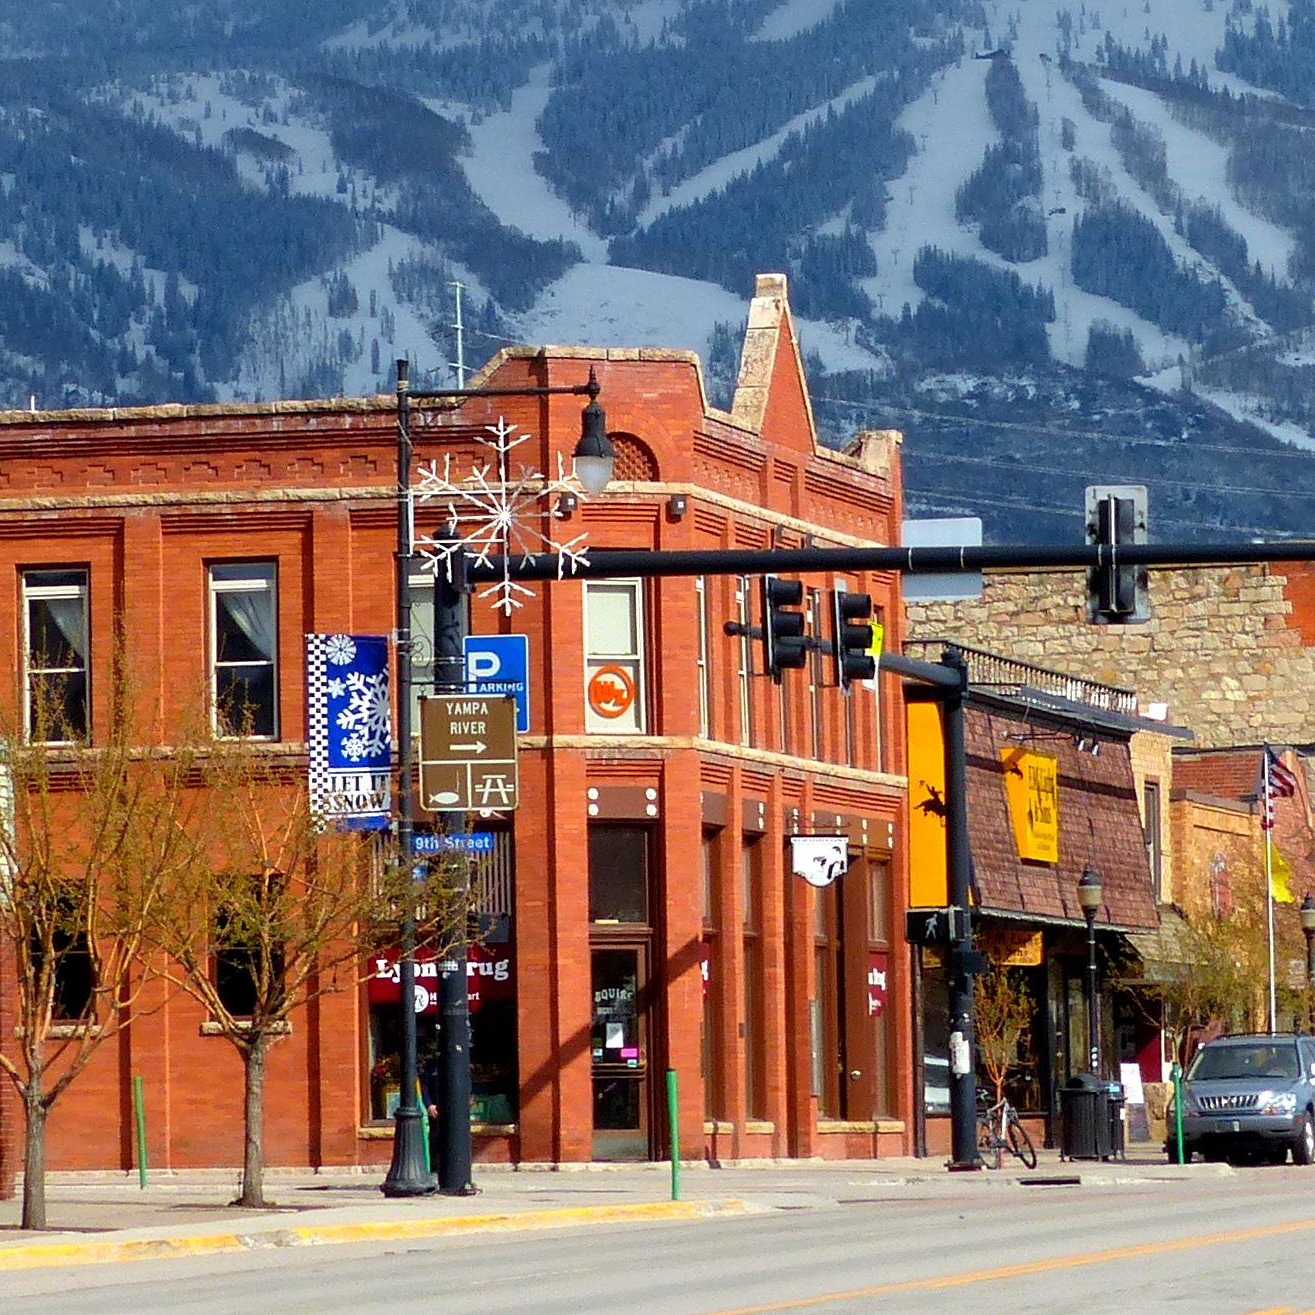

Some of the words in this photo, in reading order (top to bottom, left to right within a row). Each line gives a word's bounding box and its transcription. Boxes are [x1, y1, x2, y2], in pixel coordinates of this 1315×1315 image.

[446, 702, 489, 715] YAMPA
[450, 721, 486, 735] RIVER
[329, 775, 363, 793] LET
[371, 774, 389, 792] IT
[332, 793, 386, 813] SNOW
[415, 836, 439, 850] 9th
[444, 836, 490, 849] Street
[466, 959, 509, 981] rug
